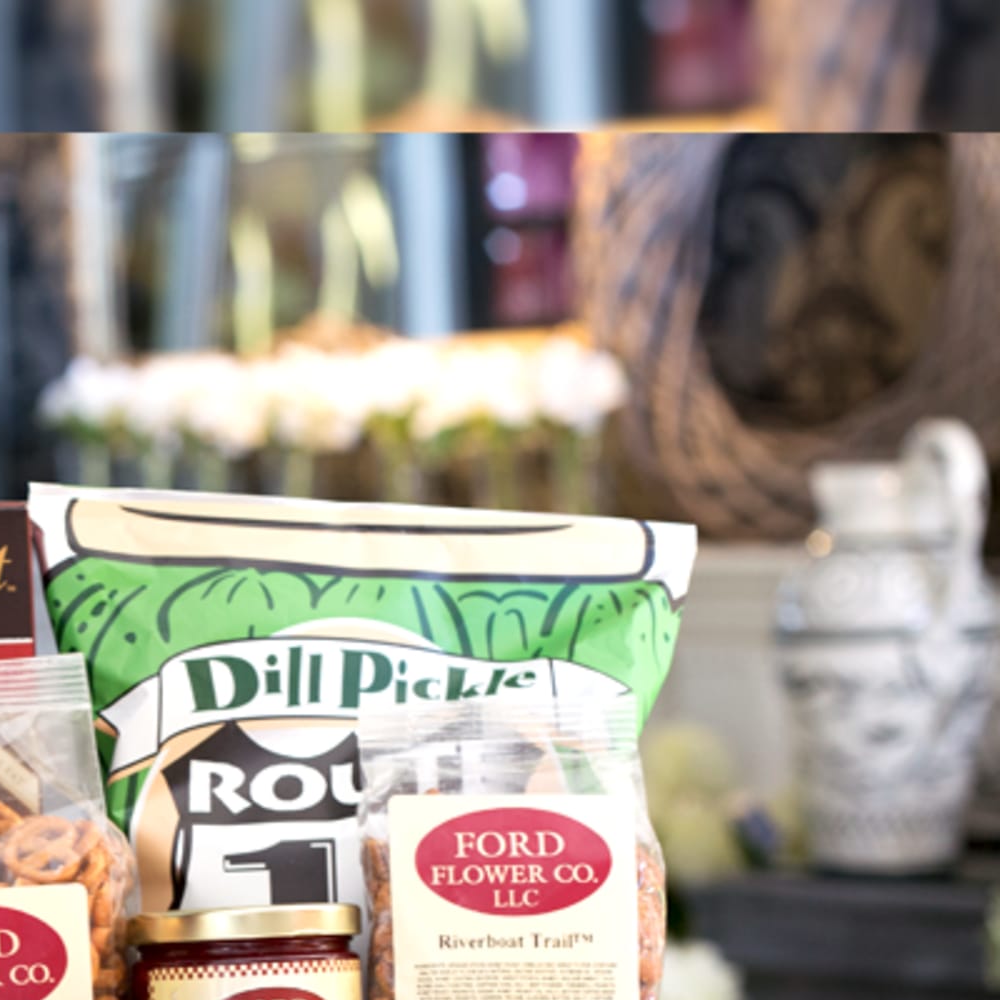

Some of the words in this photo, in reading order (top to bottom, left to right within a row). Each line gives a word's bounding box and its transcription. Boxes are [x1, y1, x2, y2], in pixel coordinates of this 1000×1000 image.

[182, 645, 323, 713] Dill
[338, 648, 538, 709] Pickle
[454, 829, 566, 859] FORD
[429, 863, 548, 886] FLOWER
[553, 862, 600, 885] CO.
[492, 888, 540, 910] LLC
[437, 933, 525, 950] Riverboat
[9, 962, 56, 987] CO.
